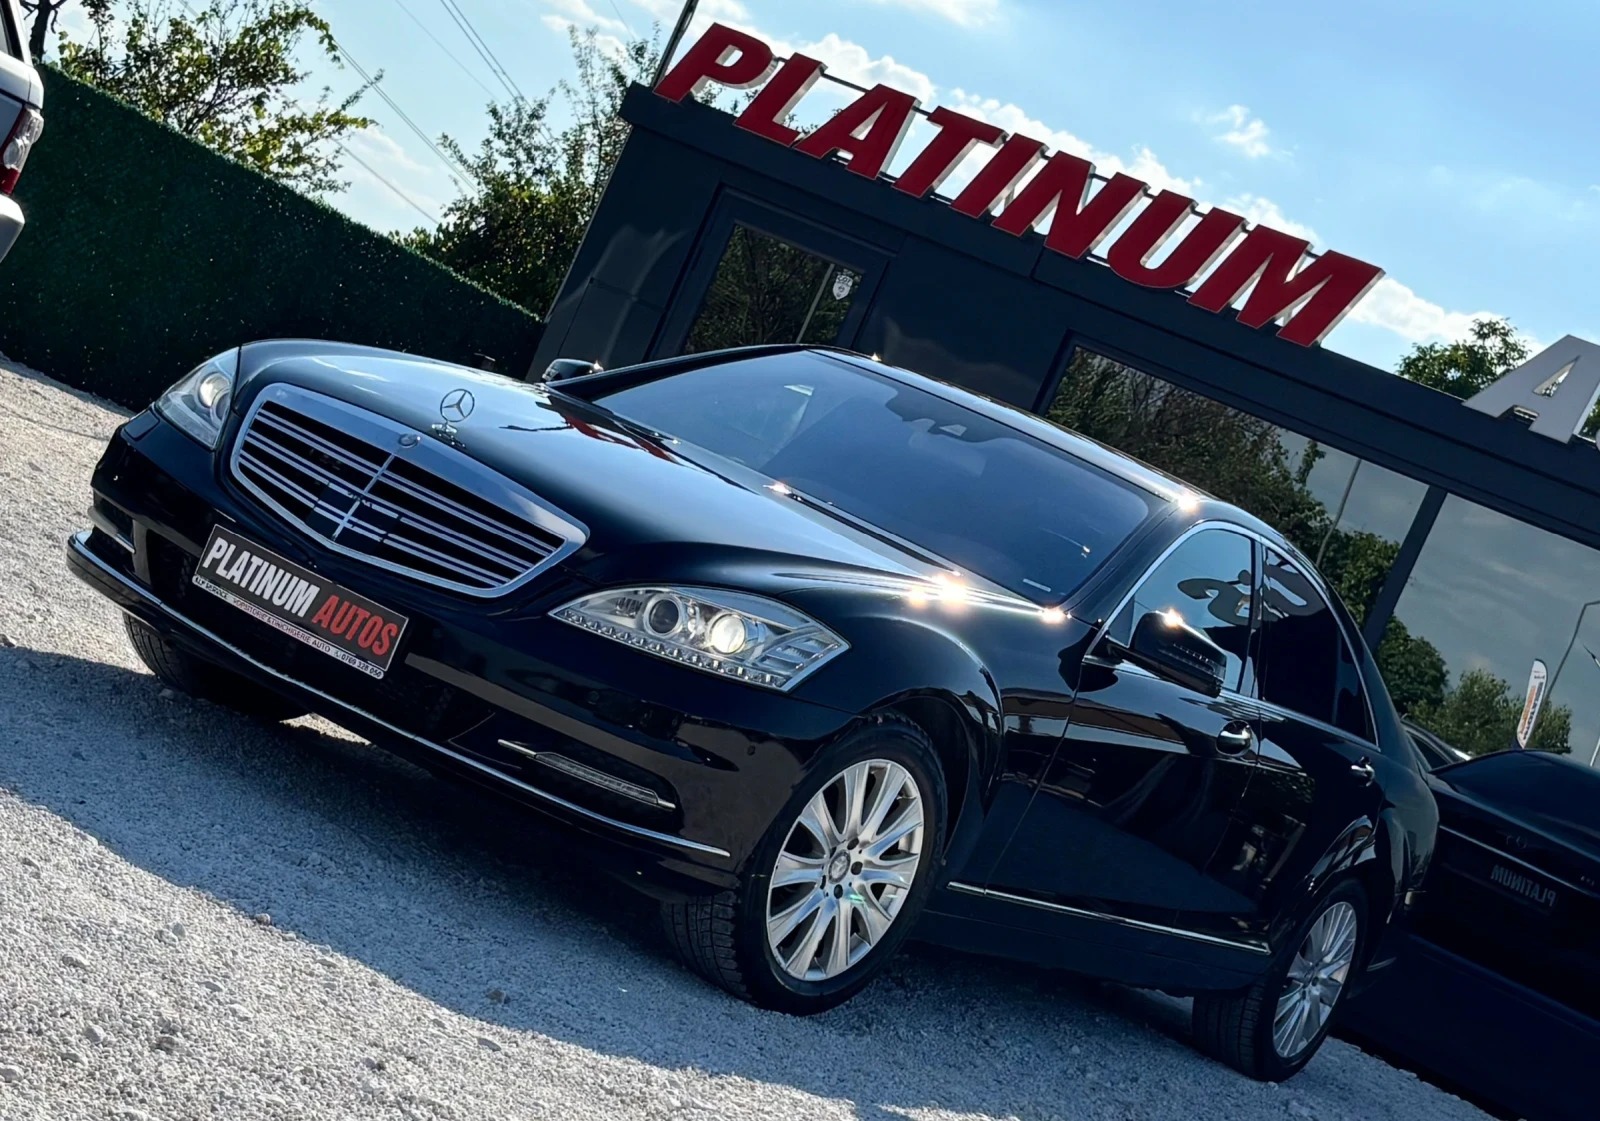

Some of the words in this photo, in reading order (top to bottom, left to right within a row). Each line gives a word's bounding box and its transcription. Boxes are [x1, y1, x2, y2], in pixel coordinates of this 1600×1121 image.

[652, 22, 1385, 347] PLATINUM
[1461, 334, 1600, 452] A
[202, 536, 321, 618] PLATINUM
[311, 594, 399, 656] AUTOS
[311, 639, 331, 653] AUTO
